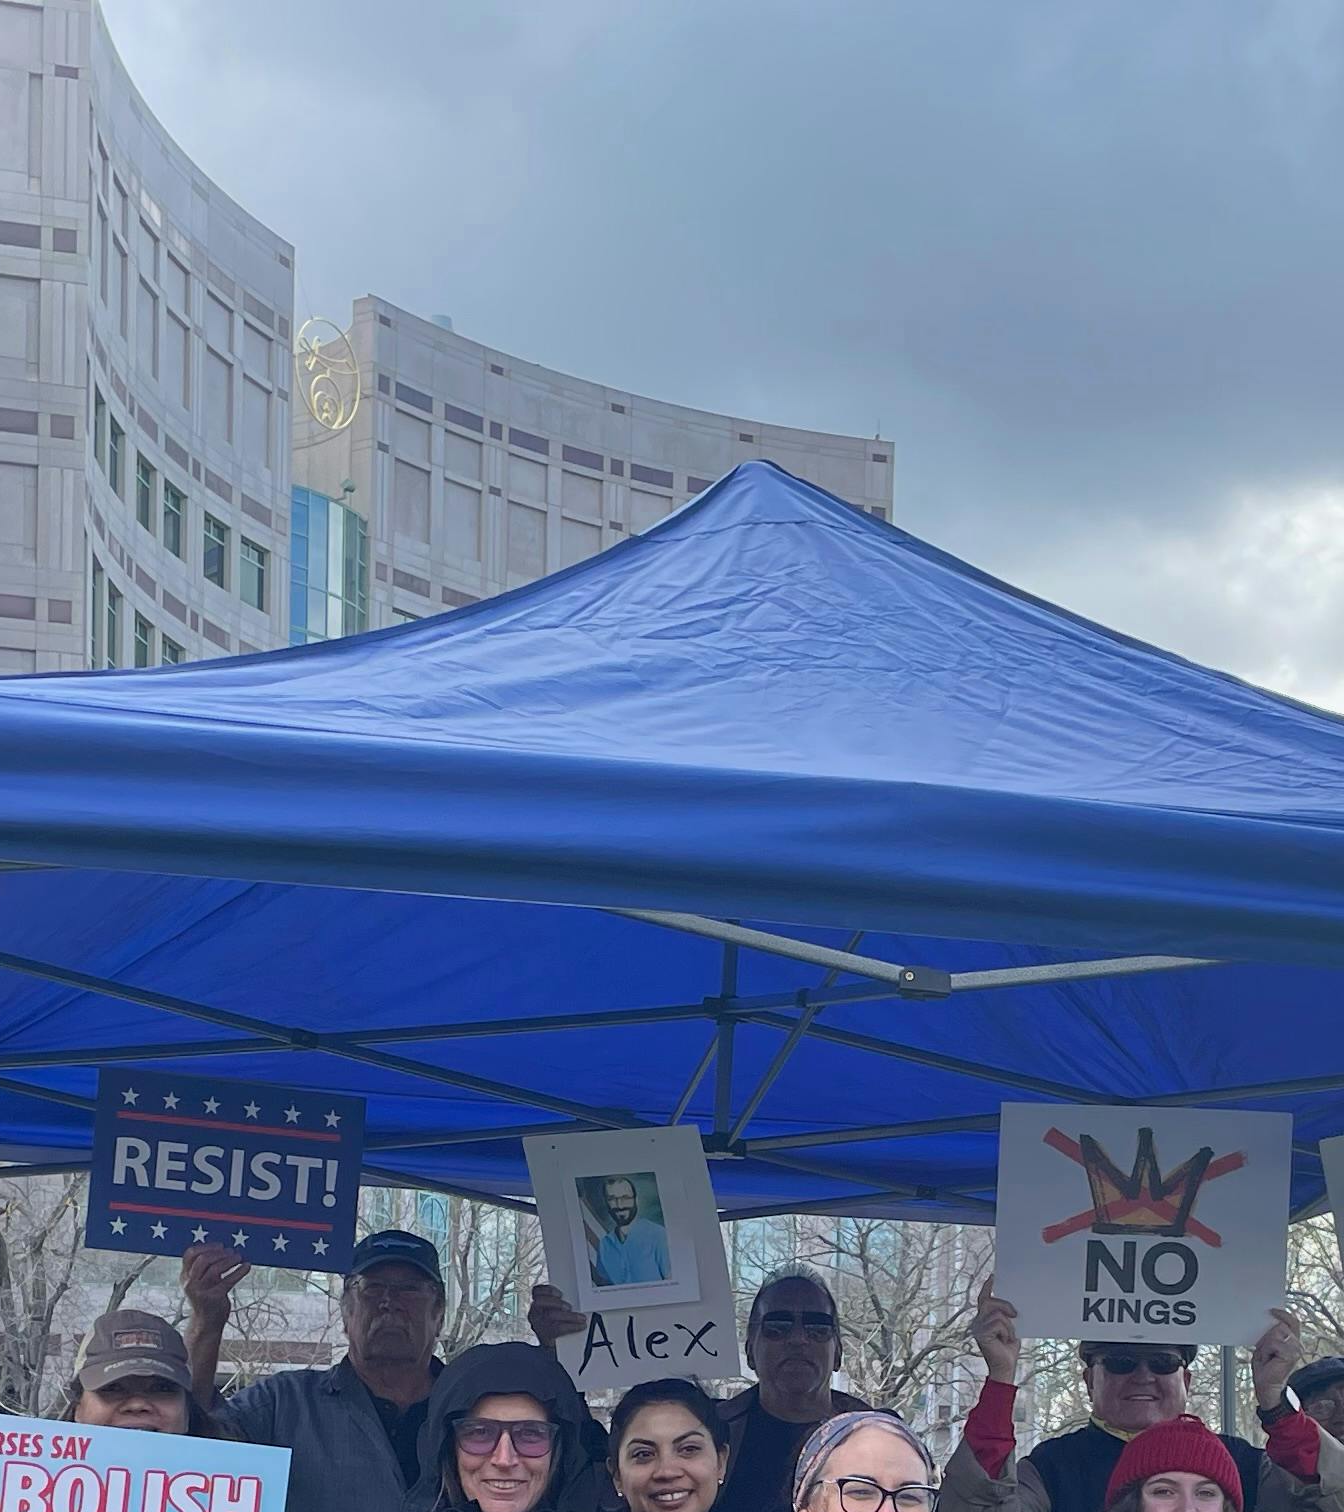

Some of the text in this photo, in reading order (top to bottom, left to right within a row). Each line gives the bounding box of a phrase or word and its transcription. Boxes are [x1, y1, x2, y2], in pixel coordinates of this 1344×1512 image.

[112, 1136, 339, 1208] RESIST!
[1084, 1239, 1198, 1296] NO
[1082, 1298, 1197, 1326] KINGS
[579, 1311, 717, 1376] Alex
[50, 1435, 93, 1461] SAY
